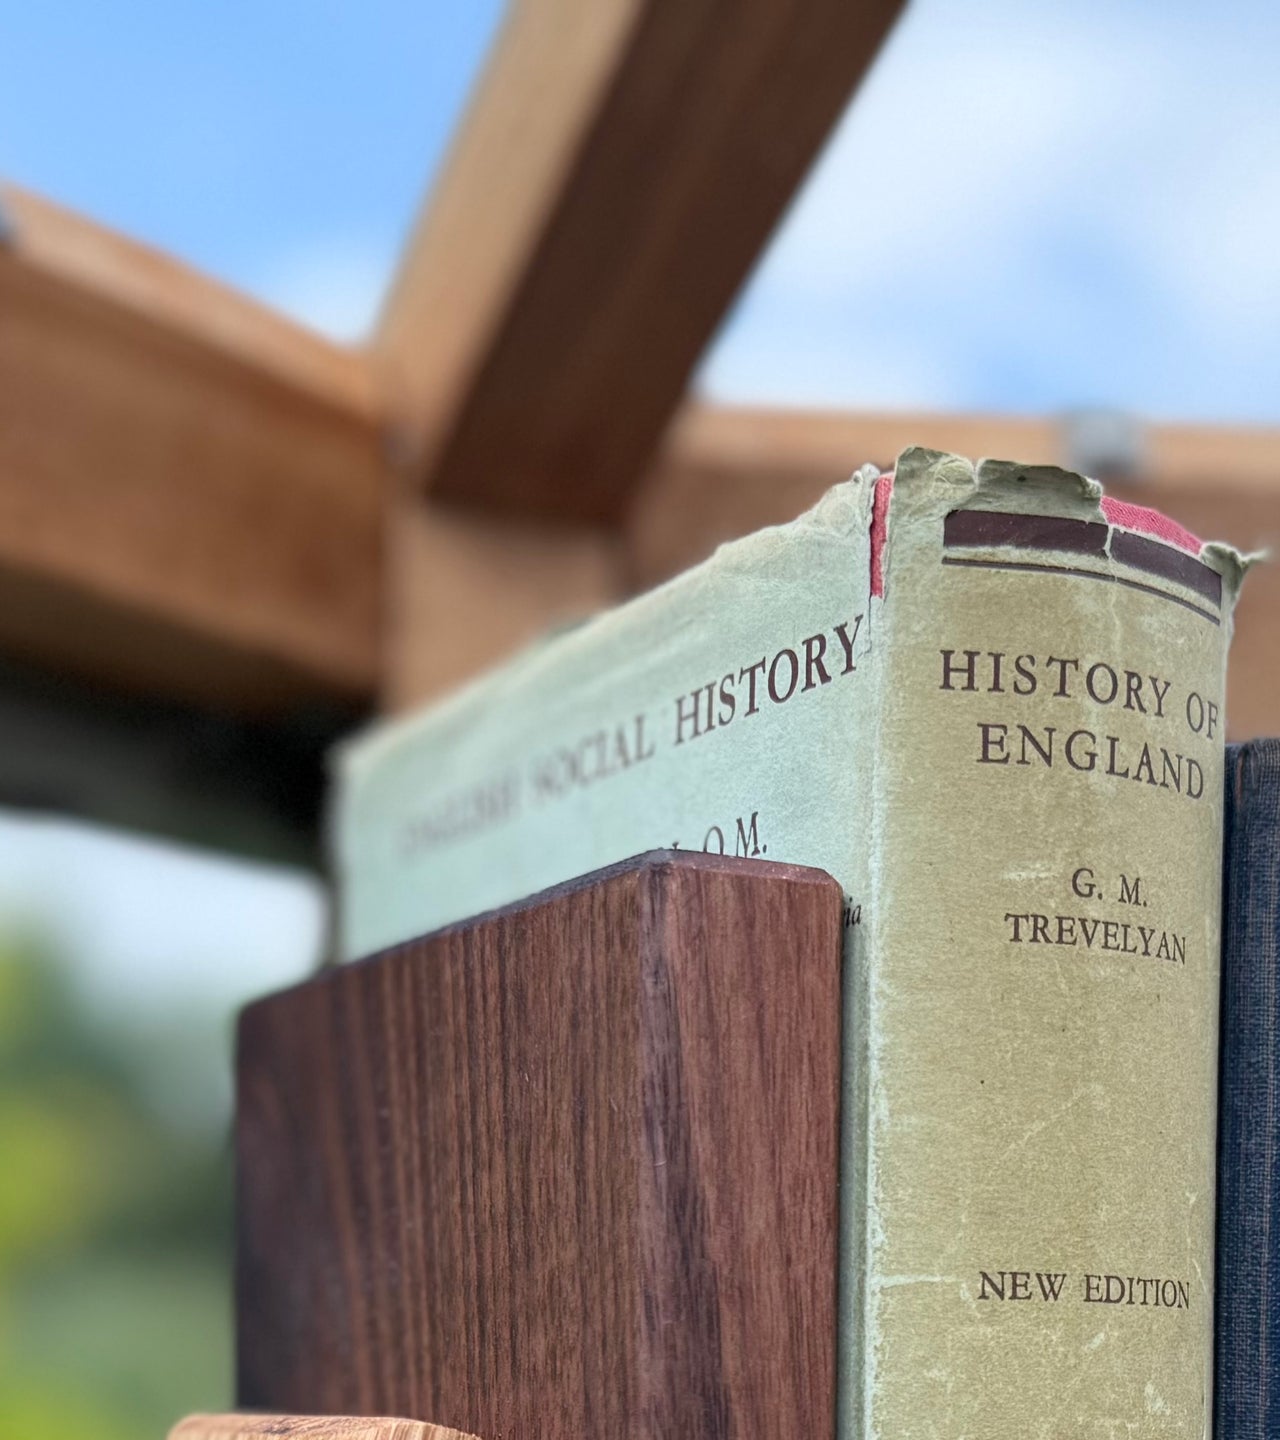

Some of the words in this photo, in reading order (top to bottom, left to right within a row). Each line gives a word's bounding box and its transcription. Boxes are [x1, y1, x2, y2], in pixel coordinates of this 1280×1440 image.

[529, 713, 656, 806] SOCIAL
[674, 614, 864, 745] HISTORY
[938, 649, 1171, 718] HISTORY
[1186, 691, 1219, 740] OF
[976, 722, 1204, 799] ENGLAND
[1071, 867, 1104, 901] G.
[1117, 873, 1148, 908] M.
[1004, 911, 1187, 965] TREVELYAN
[977, 1271, 1068, 1302] NEW
[1083, 1274, 1190, 1310] EDITION
